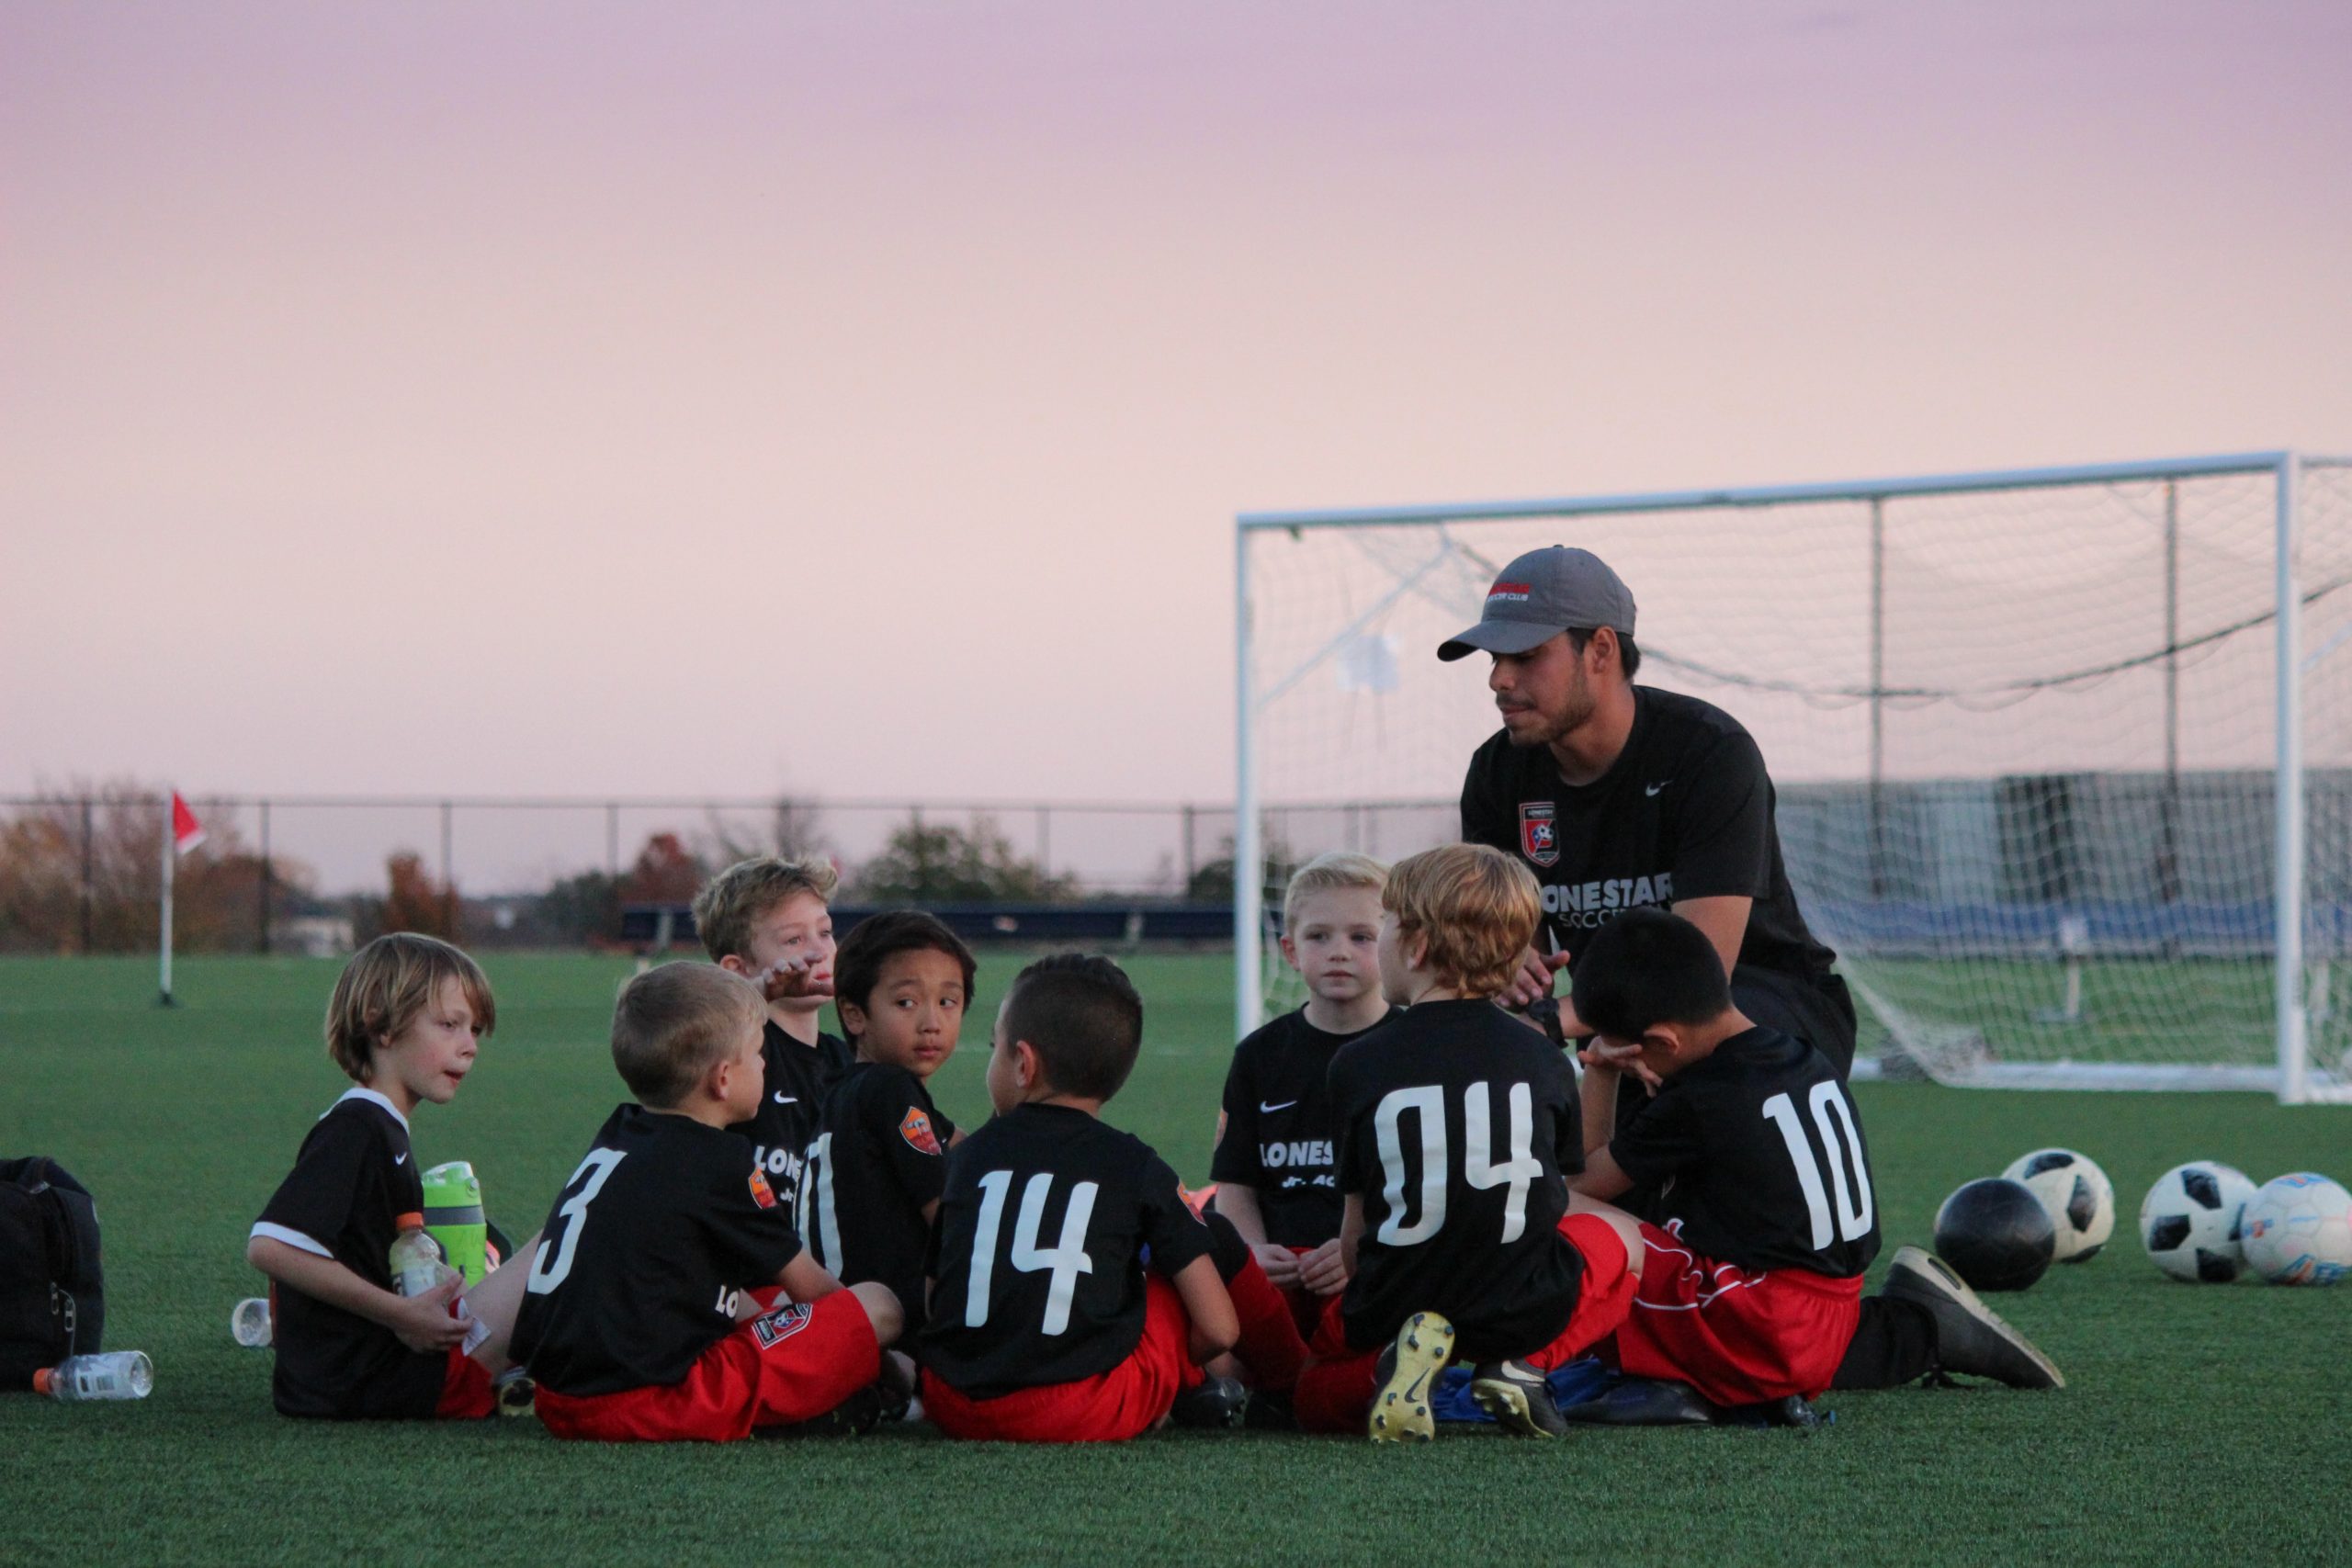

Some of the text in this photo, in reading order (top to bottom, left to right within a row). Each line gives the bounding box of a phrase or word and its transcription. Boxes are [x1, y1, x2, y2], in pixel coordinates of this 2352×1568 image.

[1542, 873, 1673, 913] ONESTAR
[527, 1147, 628, 1294] 3
[1374, 1081, 1544, 1246] 04
[1762, 1080, 1873, 1250] 10
[966, 1170, 1099, 1336] 14
